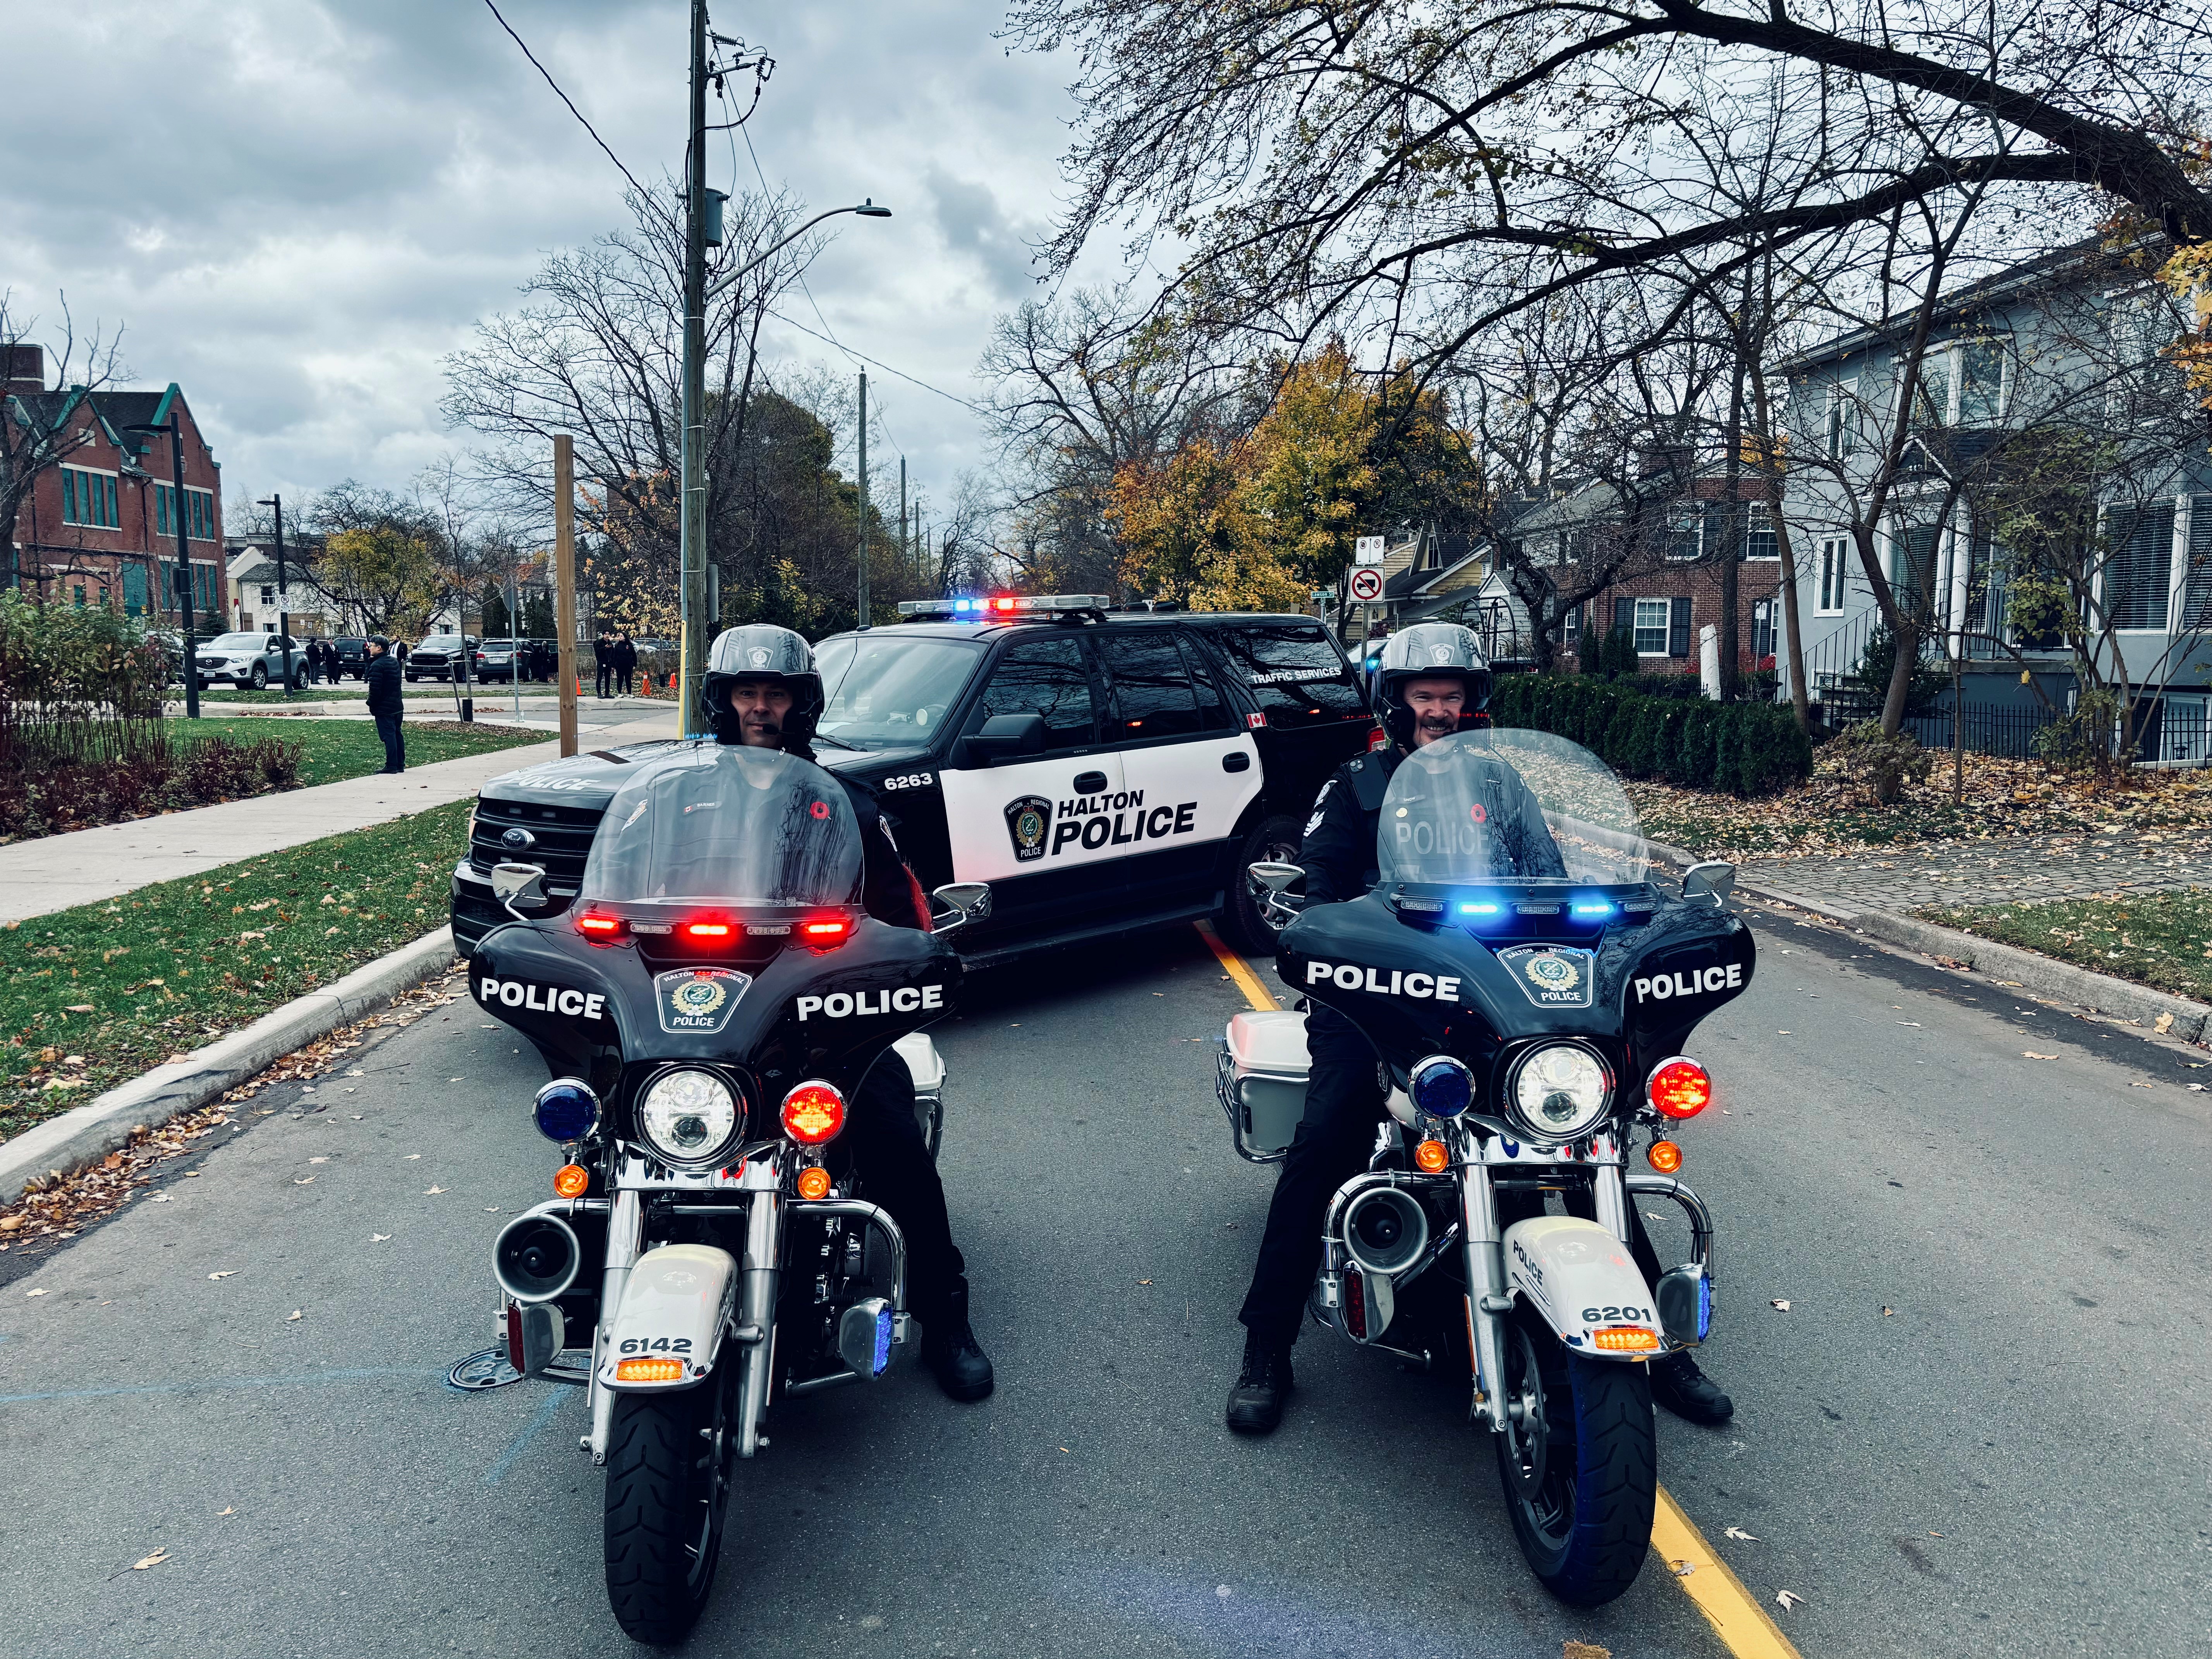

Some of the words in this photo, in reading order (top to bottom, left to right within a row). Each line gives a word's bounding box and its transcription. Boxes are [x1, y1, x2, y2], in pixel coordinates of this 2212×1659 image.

[1250, 672, 1293, 684] TRAFFIC
[1294, 667, 1341, 680] SERVICES
[505, 774, 601, 790] POLICE
[884, 773, 933, 790] 6263
[1007, 801, 1023, 815] HALTON
[1030, 799, 1049, 810] REGIONAL
[1058, 789, 1144, 819] HALTON
[1051, 802, 1197, 856] POLICE
[1395, 821, 1491, 855] POLICE
[1020, 846, 1041, 858] POLICE
[1506, 948, 1534, 959] HALTON
[1548, 947, 1585, 959] REGIONAL
[663, 971, 694, 982] HALTON
[710, 970, 745, 984] REGIONAL
[1307, 961, 1461, 1002] POLICE
[1634, 963, 1742, 1004] POLICE
[481, 977, 606, 1020] POLICE
[797, 984, 943, 1021] POLICE
[1540, 992, 1582, 1001] POLICE
[673, 1017, 715, 1027] POLICE
[1513, 1239, 1543, 1286] POLICE
[1582, 1306, 1652, 1322] 6201
[620, 1338, 692, 1353] 6142
